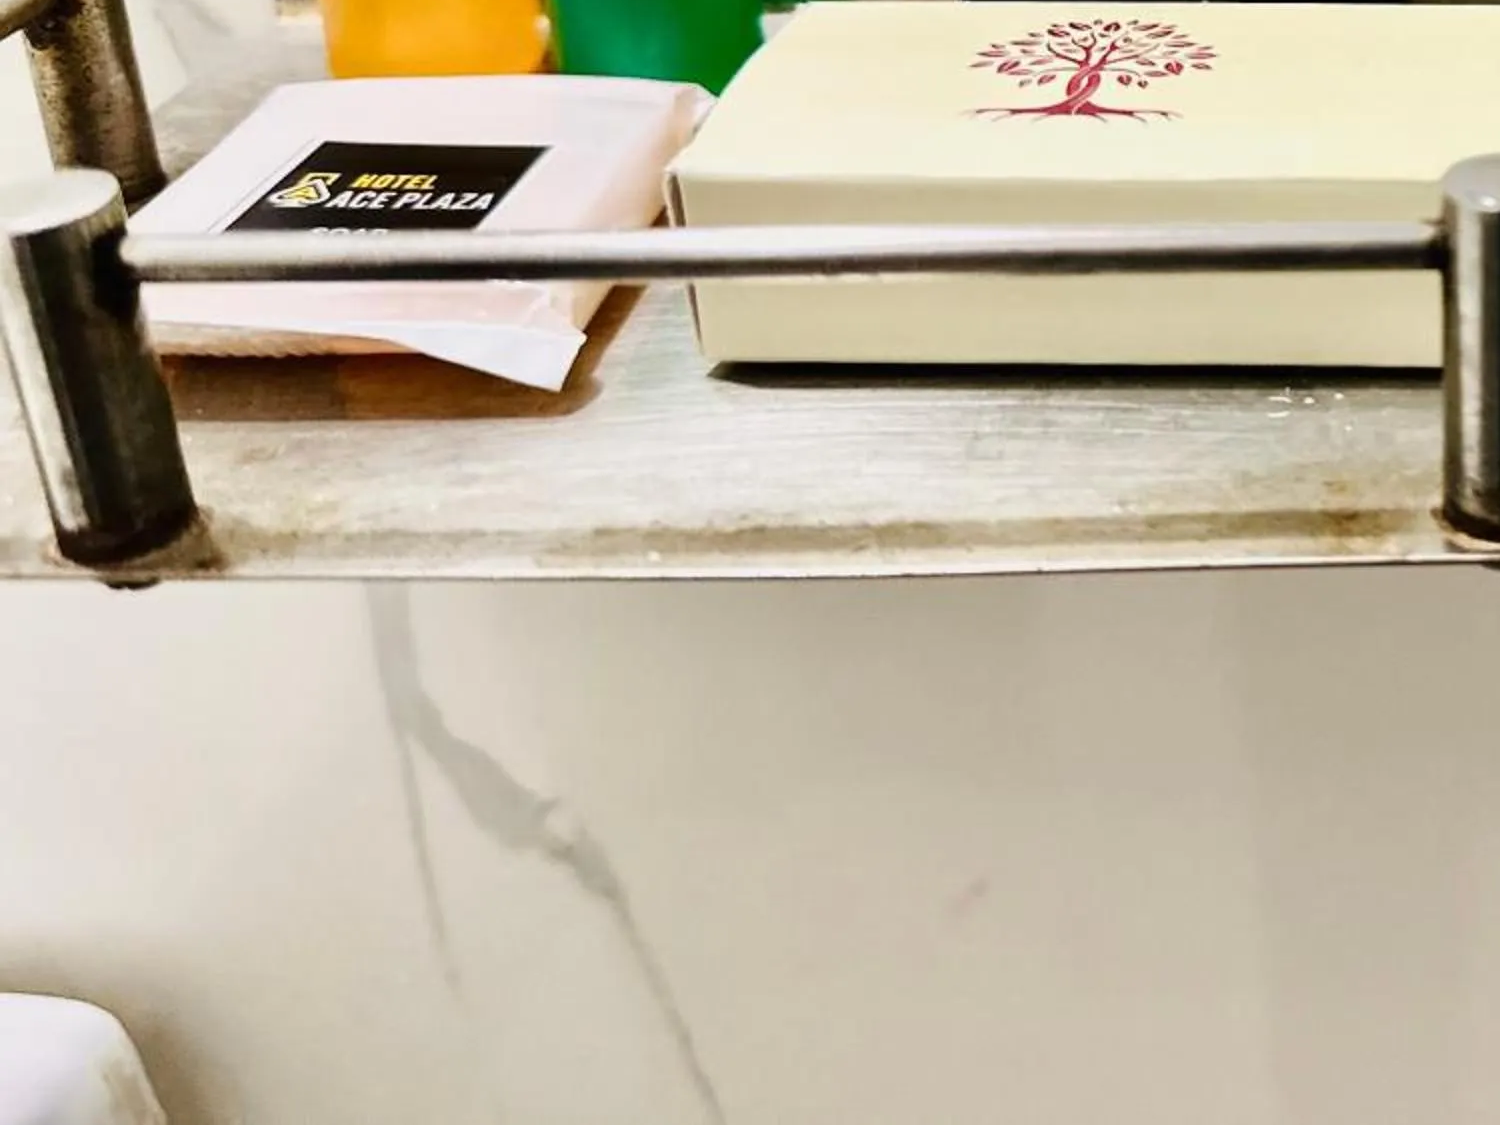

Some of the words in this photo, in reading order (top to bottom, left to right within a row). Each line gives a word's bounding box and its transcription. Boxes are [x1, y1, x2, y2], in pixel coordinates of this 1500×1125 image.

[349, 174, 440, 191] HOTEL
[324, 190, 397, 210] ACE
[390, 192, 495, 211] PLAZA
